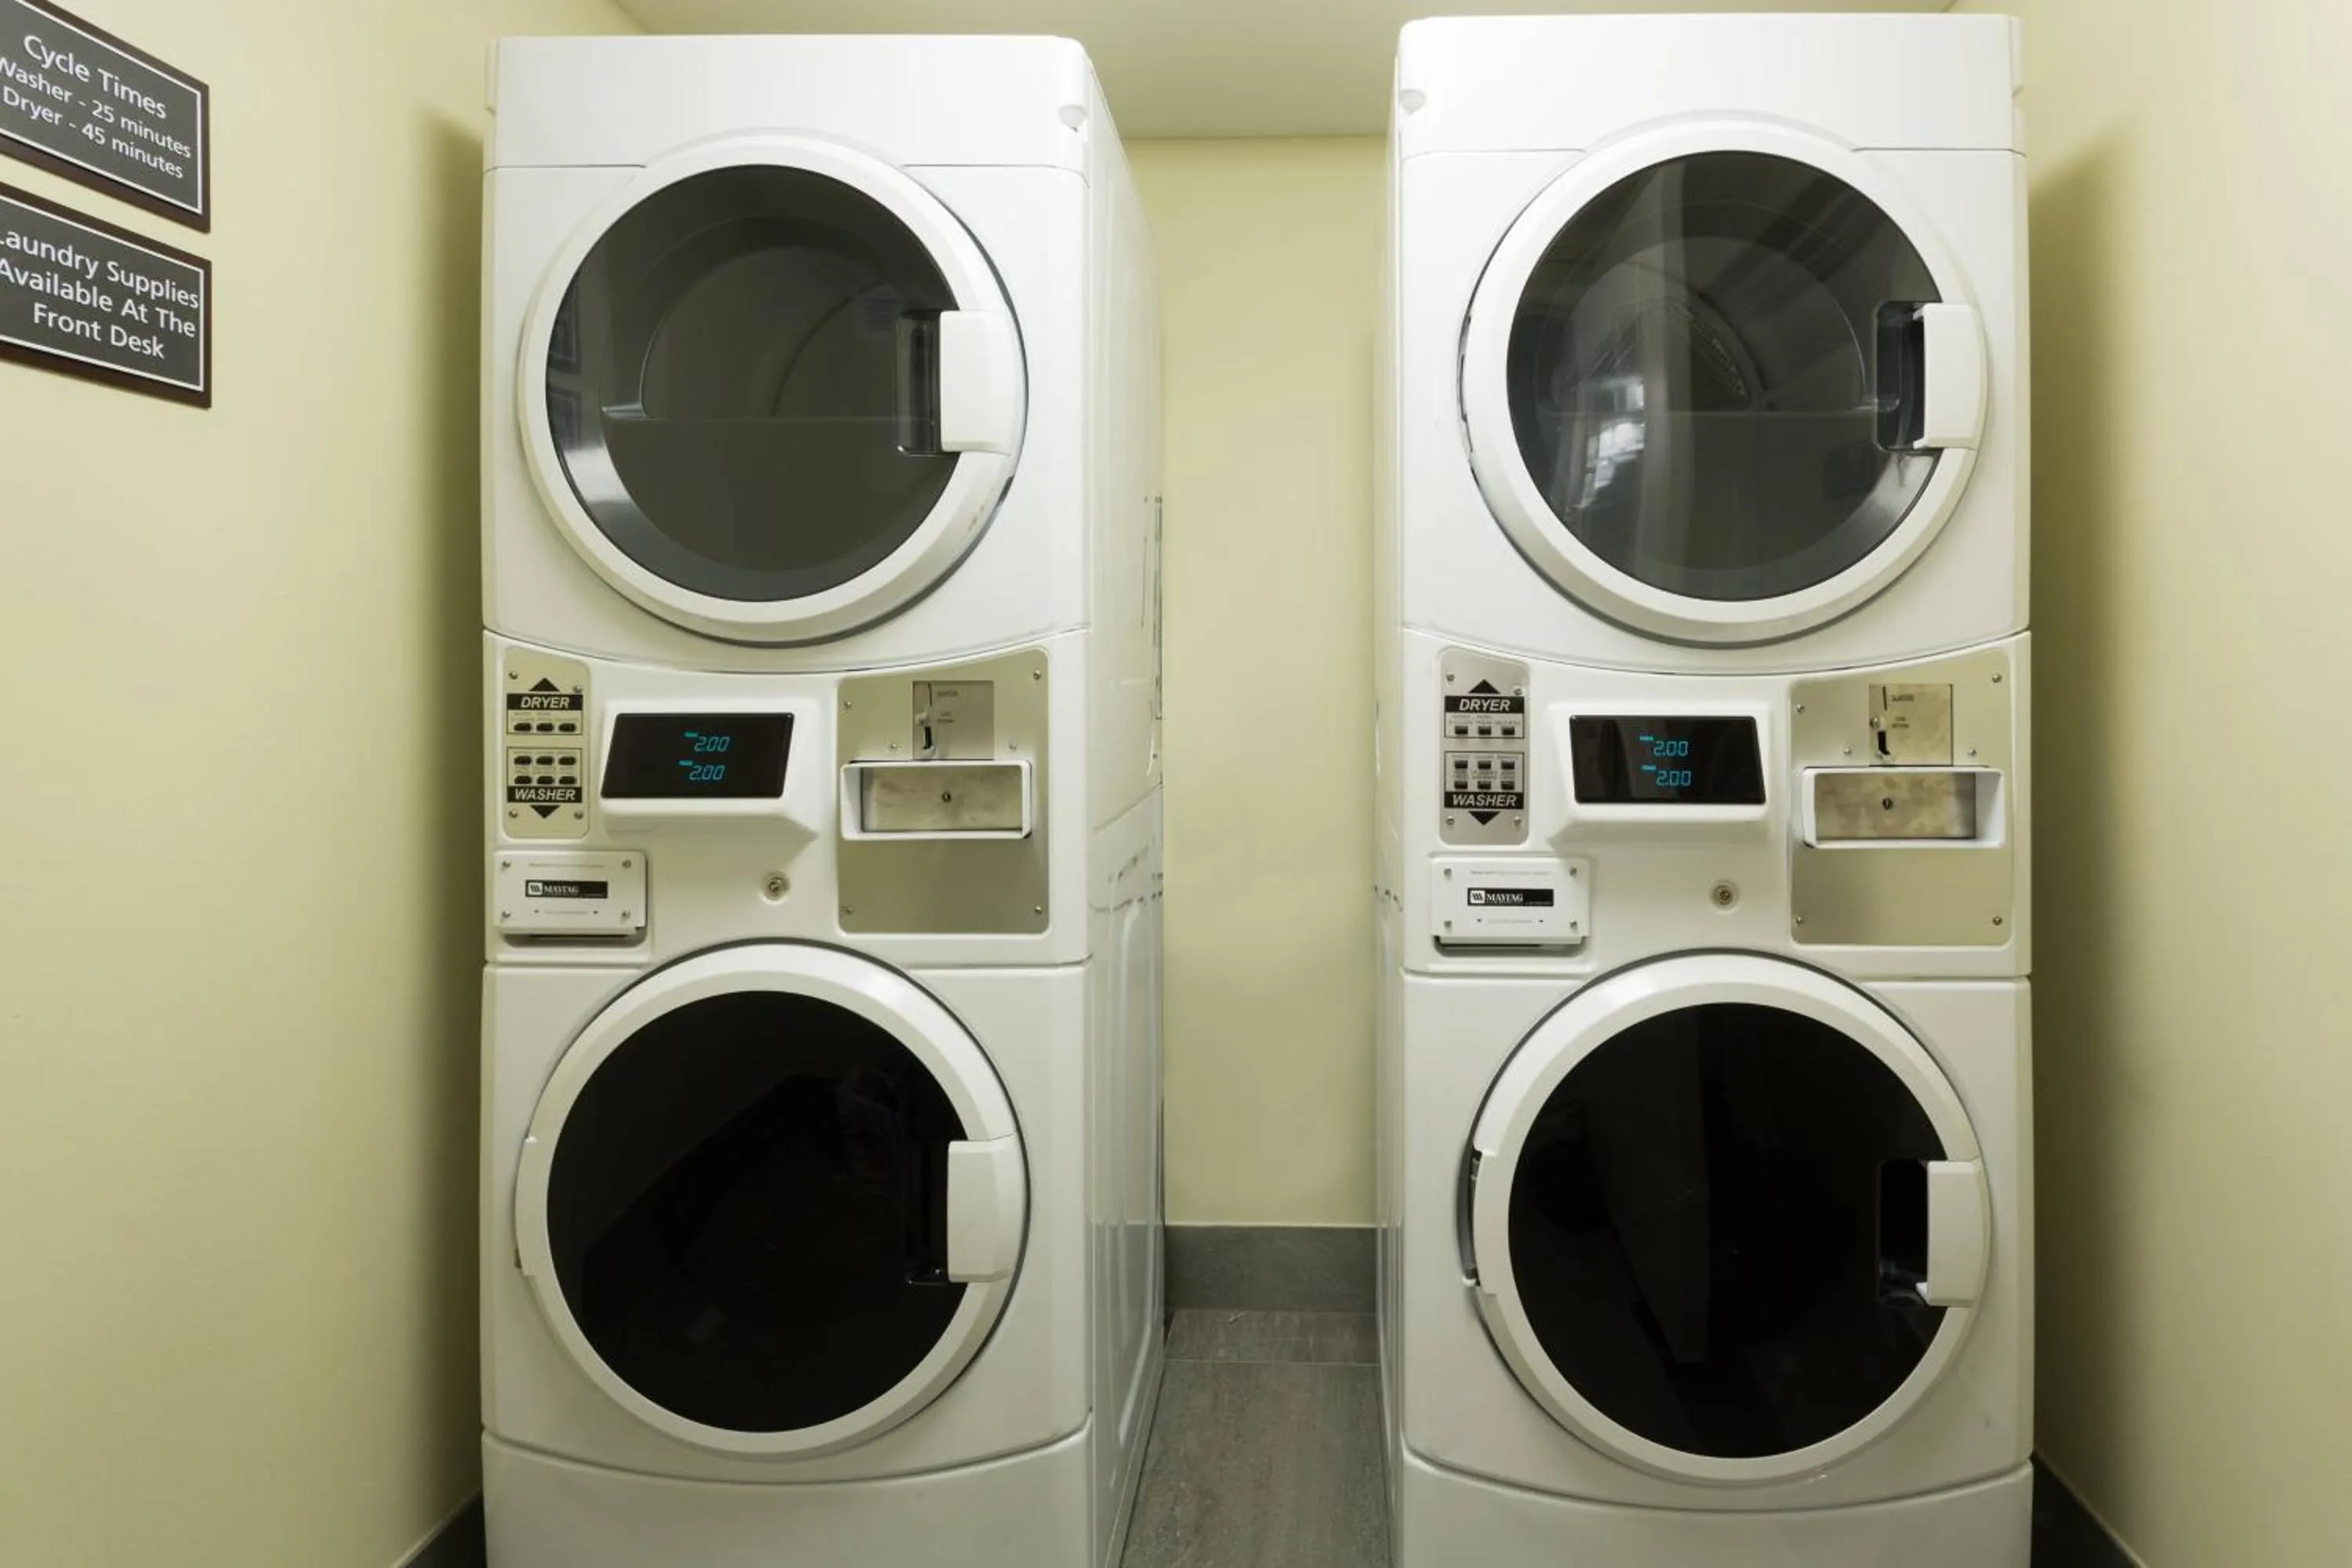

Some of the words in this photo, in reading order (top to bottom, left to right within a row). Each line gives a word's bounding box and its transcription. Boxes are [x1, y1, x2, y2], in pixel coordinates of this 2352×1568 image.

[24, 34, 91, 83] Cycle
[97, 68, 166, 118] Times
[3, 85, 64, 125] Dryer
[82, 123, 105, 145] 45
[112, 137, 183, 179] minutes
[92, 100, 114, 123] 25
[121, 116, 191, 158] minutes
[107, 260, 198, 309] Supplies
[0, 257, 114, 313] Available
[121, 298, 148, 324] At
[154, 307, 196, 338] The
[34, 302, 102, 342] Front
[111, 324, 165, 360] Desk
[521, 695, 571, 709] DRYER
[1458, 699, 1512, 712] DRYER
[1653, 740, 1690, 757] 2.00
[1656, 770, 1692, 786] 2.00
[514, 788, 576, 801] WASHER
[1452, 793, 1518, 808] WASHER
[1486, 893, 1523, 904] MAYTAG
